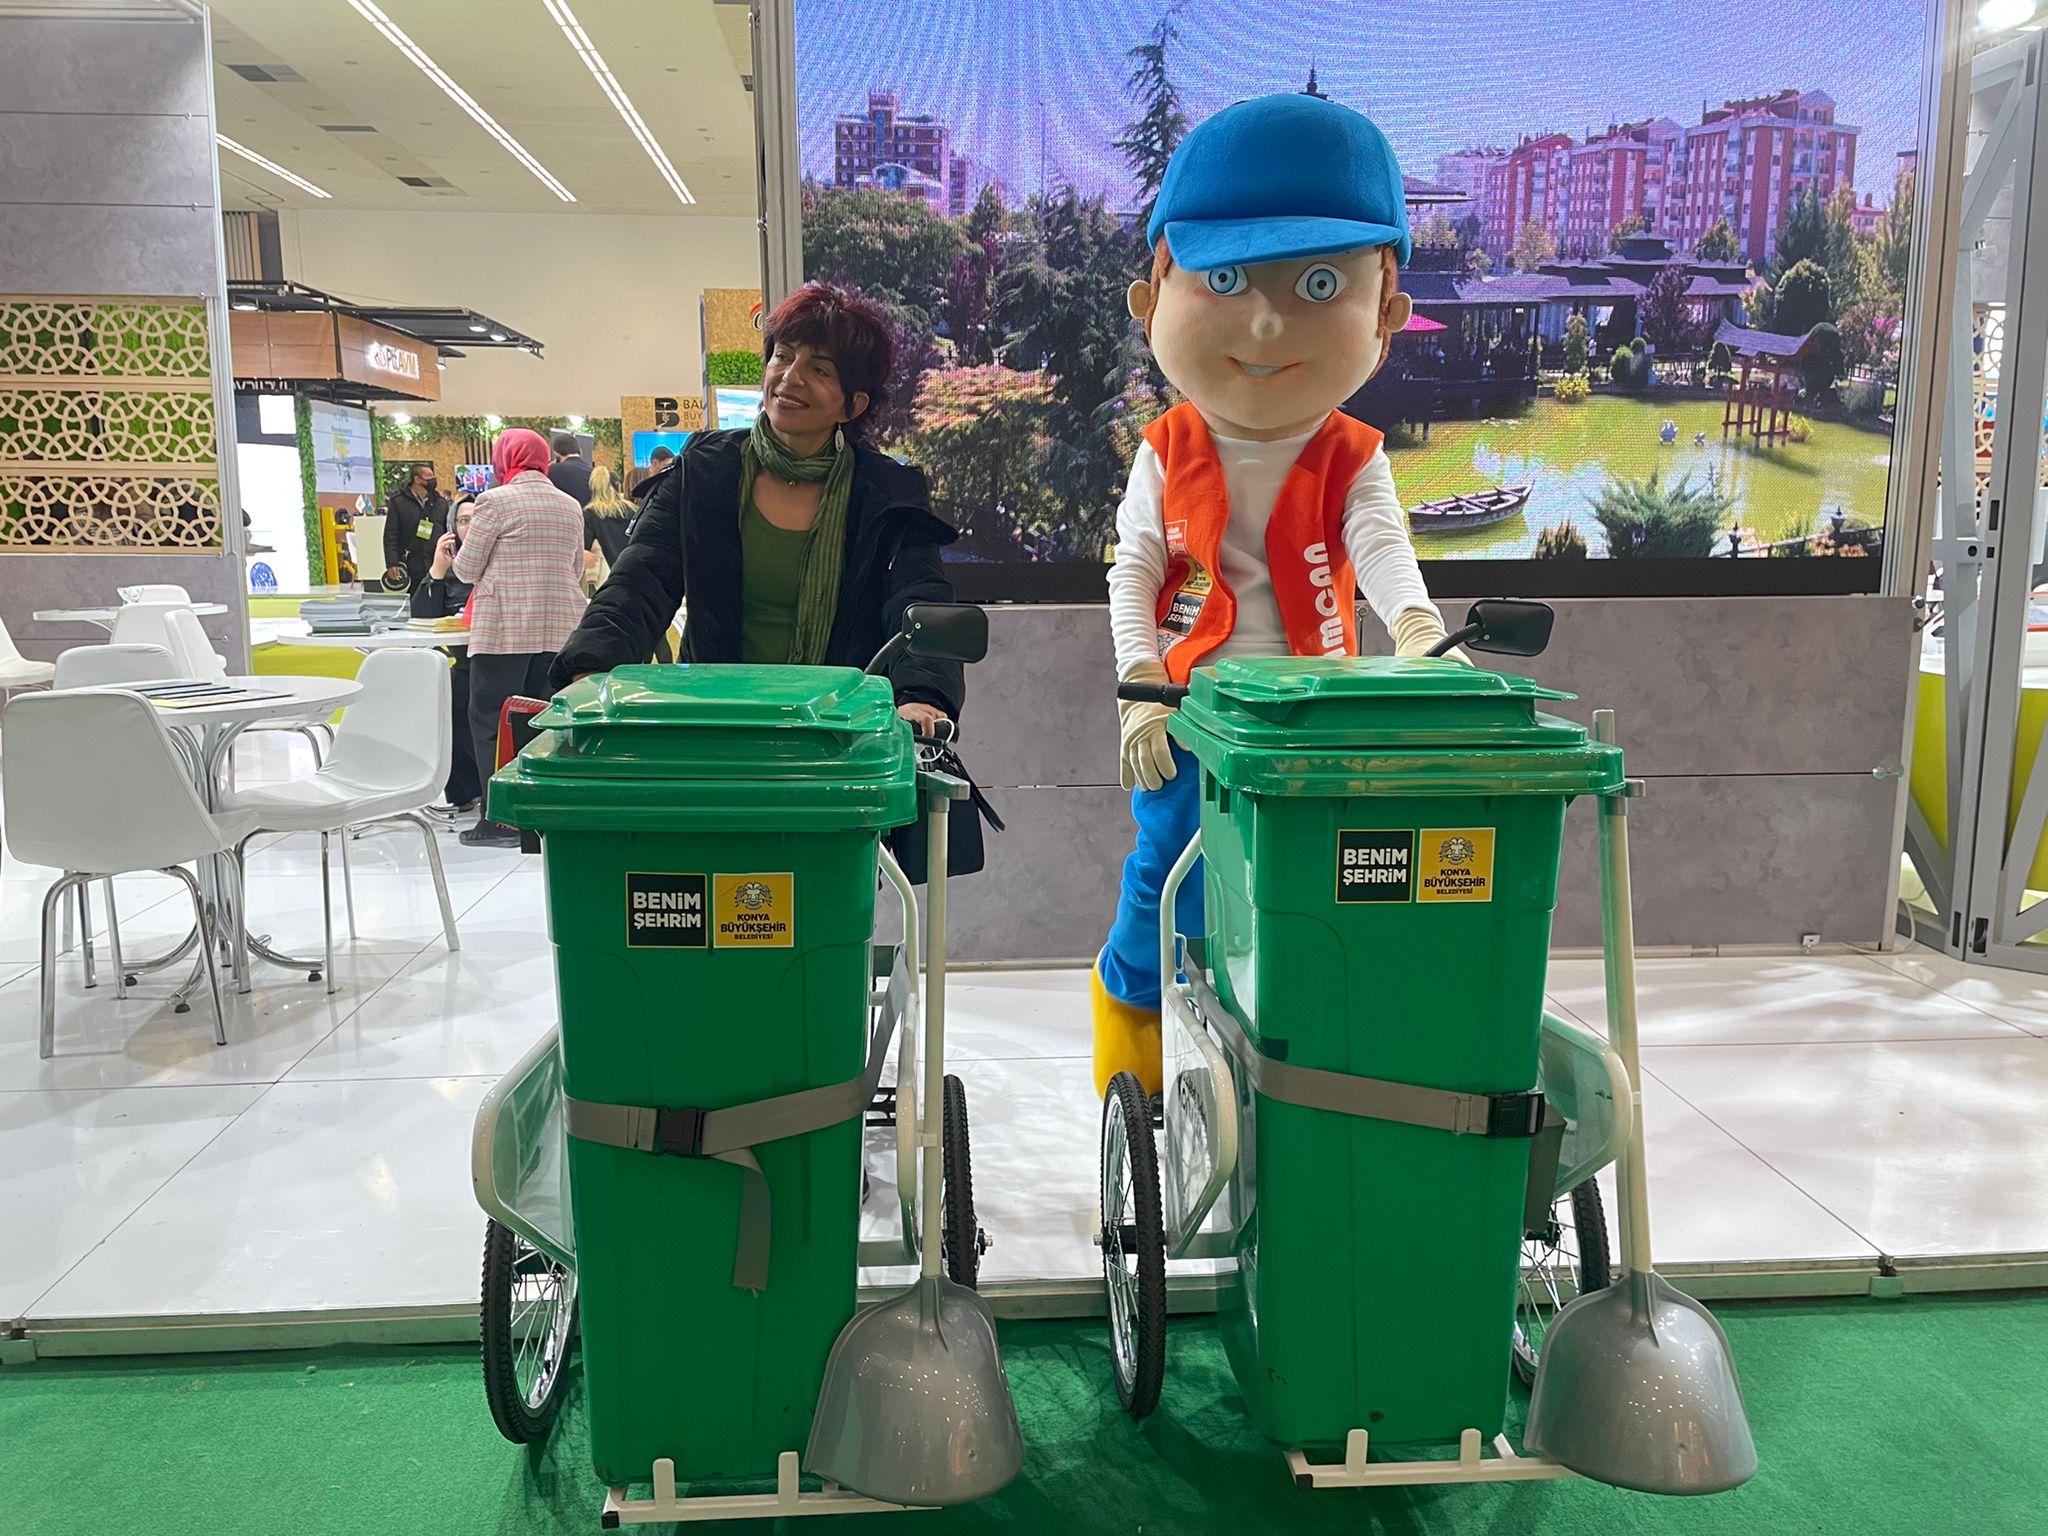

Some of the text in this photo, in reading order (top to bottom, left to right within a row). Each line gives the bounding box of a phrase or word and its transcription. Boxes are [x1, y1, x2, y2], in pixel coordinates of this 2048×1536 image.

[1303, 541, 1347, 656] mcan
[1440, 868, 1471, 877] KONYA
[736, 913, 770, 922] KONYA
